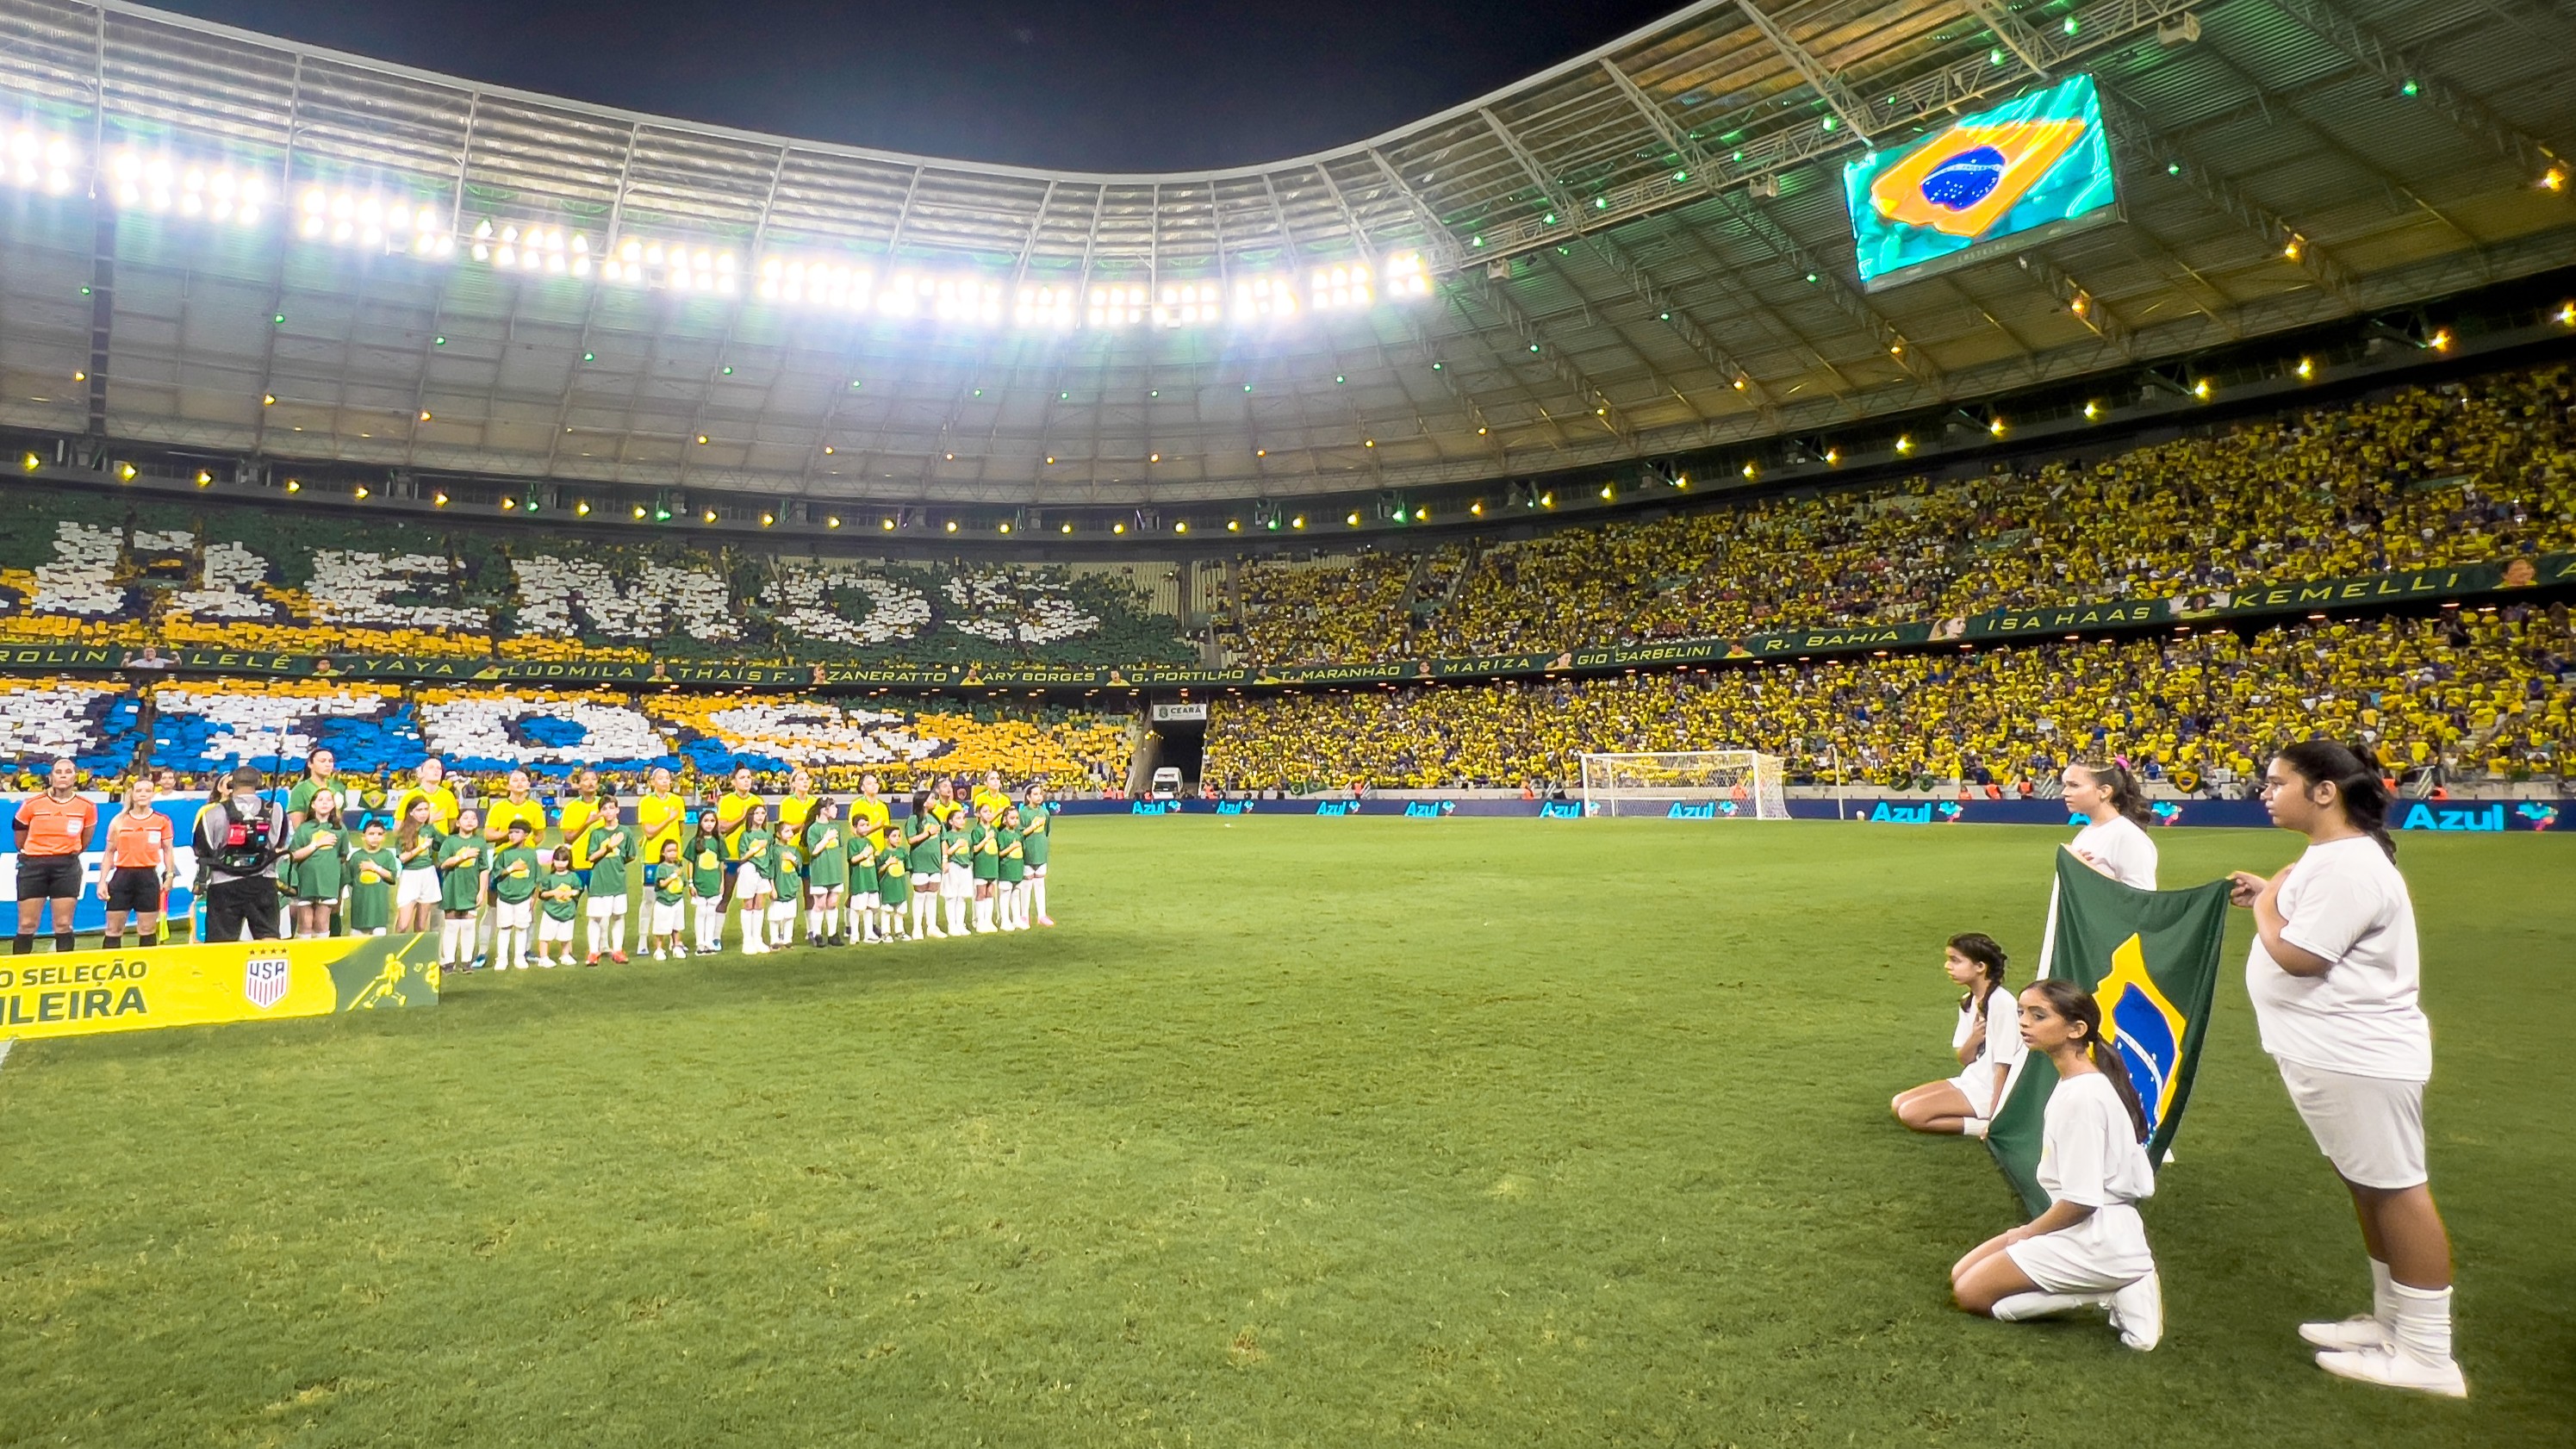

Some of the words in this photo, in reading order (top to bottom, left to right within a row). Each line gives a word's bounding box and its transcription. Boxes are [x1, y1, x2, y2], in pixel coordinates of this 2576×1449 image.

[2232, 573, 2459, 609] KEMELLI
[1987, 616, 2041, 631] ISA
[2055, 606, 2150, 626] HAAS
[1765, 639, 1790, 650] R.
[1806, 631, 1898, 646] BAHIA
[191, 653, 293, 669] LELÊ
[1577, 653, 1607, 666] GIO
[1615, 646, 1712, 662] GARBELINI
[365, 660, 454, 675] YAYA
[507, 664, 635, 678] LUDMILA
[679, 662, 762, 682] THAÍS
[773, 671, 795, 682] F.
[1301, 664, 1401, 681] MARANHÃO
[1443, 657, 1530, 674] MARIZA
[827, 669, 948, 681] ZANERATTO
[982, 671, 1017, 681] ARY
[1023, 671, 1096, 682] BORGES
[1131, 673, 1149, 683] G.
[1154, 669, 1245, 681] PORTILHO
[1132, 800, 1166, 815] Azul
[1216, 800, 1242, 815] Azul
[1316, 800, 1346, 816] Azul
[1403, 800, 1440, 817] Azul
[1540, 801, 1581, 818] Azul
[1666, 801, 1715, 818] Azul
[1870, 801, 1932, 823] Azul
[2403, 804, 2505, 831] Azul
[22, 958, 147, 987] SELEÇÃO
[250, 961, 285, 979] USA
